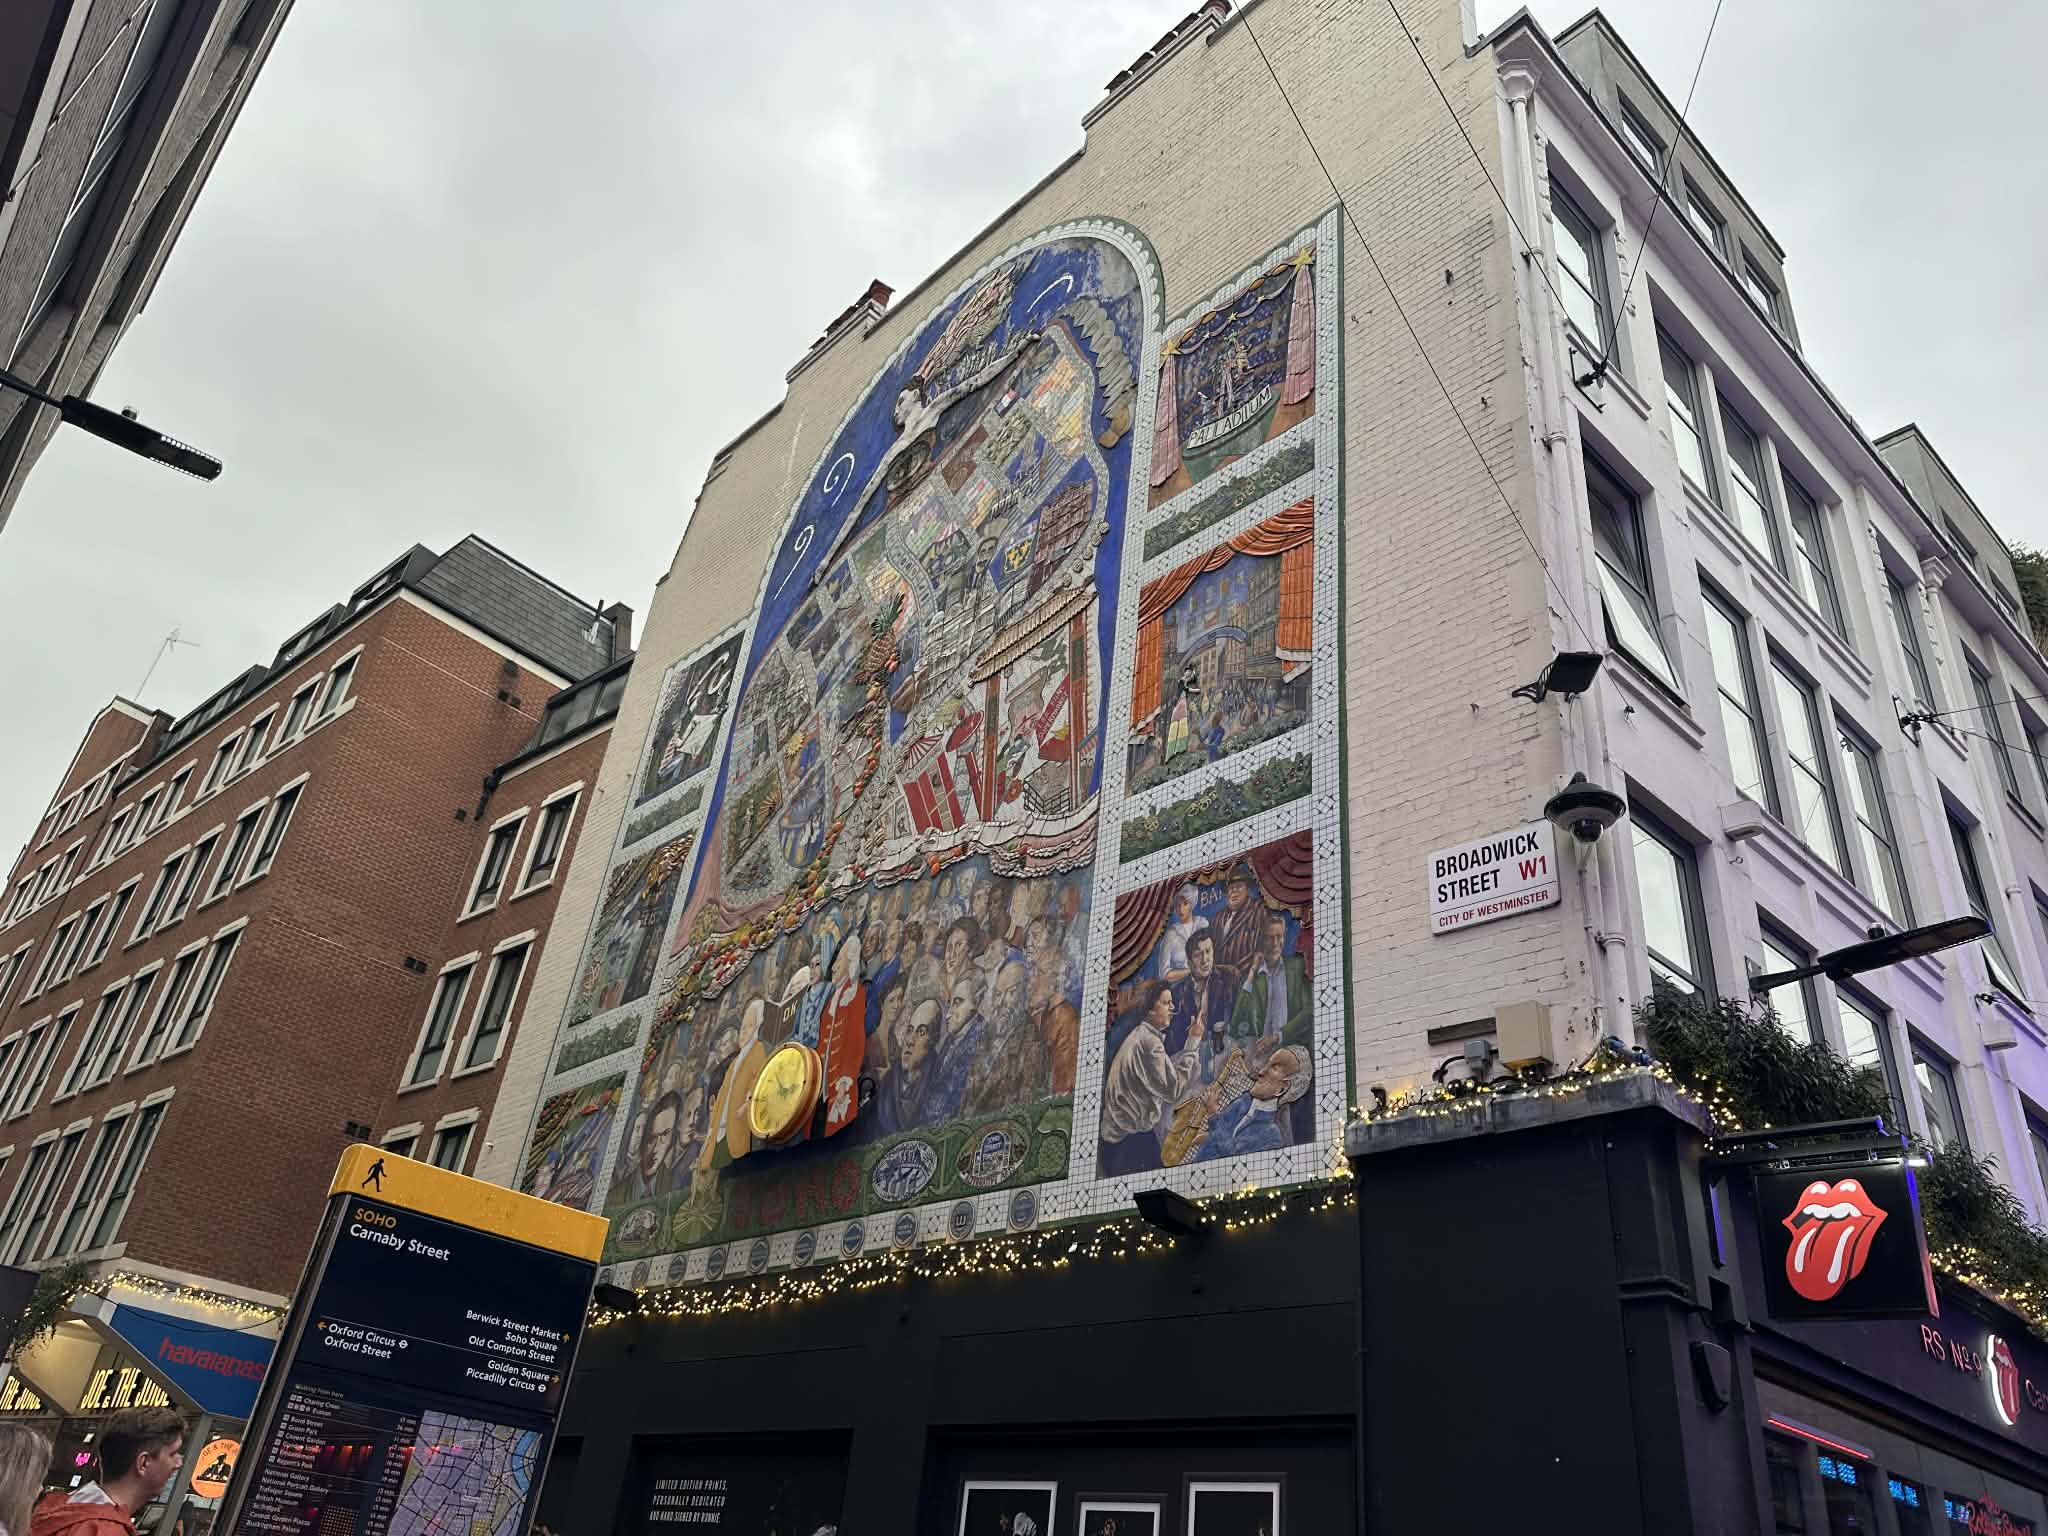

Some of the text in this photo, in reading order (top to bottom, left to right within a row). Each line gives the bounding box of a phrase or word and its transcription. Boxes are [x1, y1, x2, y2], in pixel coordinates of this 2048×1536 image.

[1436, 832, 1539, 878] BROADWICK
[1438, 855, 1547, 903] STREET W1
[1439, 890, 1549, 927] CITY OF WESTMINSTER
[355, 1208, 397, 1229] SOHO
[350, 1224, 450, 1260] Carnaby Street
[329, 1323, 396, 1347] Oxford Circus
[466, 1309, 561, 1341] Berwick Street Market
[324, 1336, 392, 1359] Oxford Street
[468, 1335, 555, 1363] Old Compton Street
[505, 1331, 558, 1352] Soho Square
[1921, 1324, 1945, 1361] RS
[158, 1337, 266, 1381] havaianas
[487, 1360, 550, 1382] Golden Square
[81, 1369, 113, 1409] JOE
[102, 1395, 111, 1408] &
[110, 1367, 141, 1408] THE
[466, 1368, 535, 1391] Piccadilly Circus
[655, 1479, 679, 1490] LIMITED
[679, 1479, 704, 1490] EDITION
[652, 1495, 726, 1507] PERSONALLY DEDICATED
